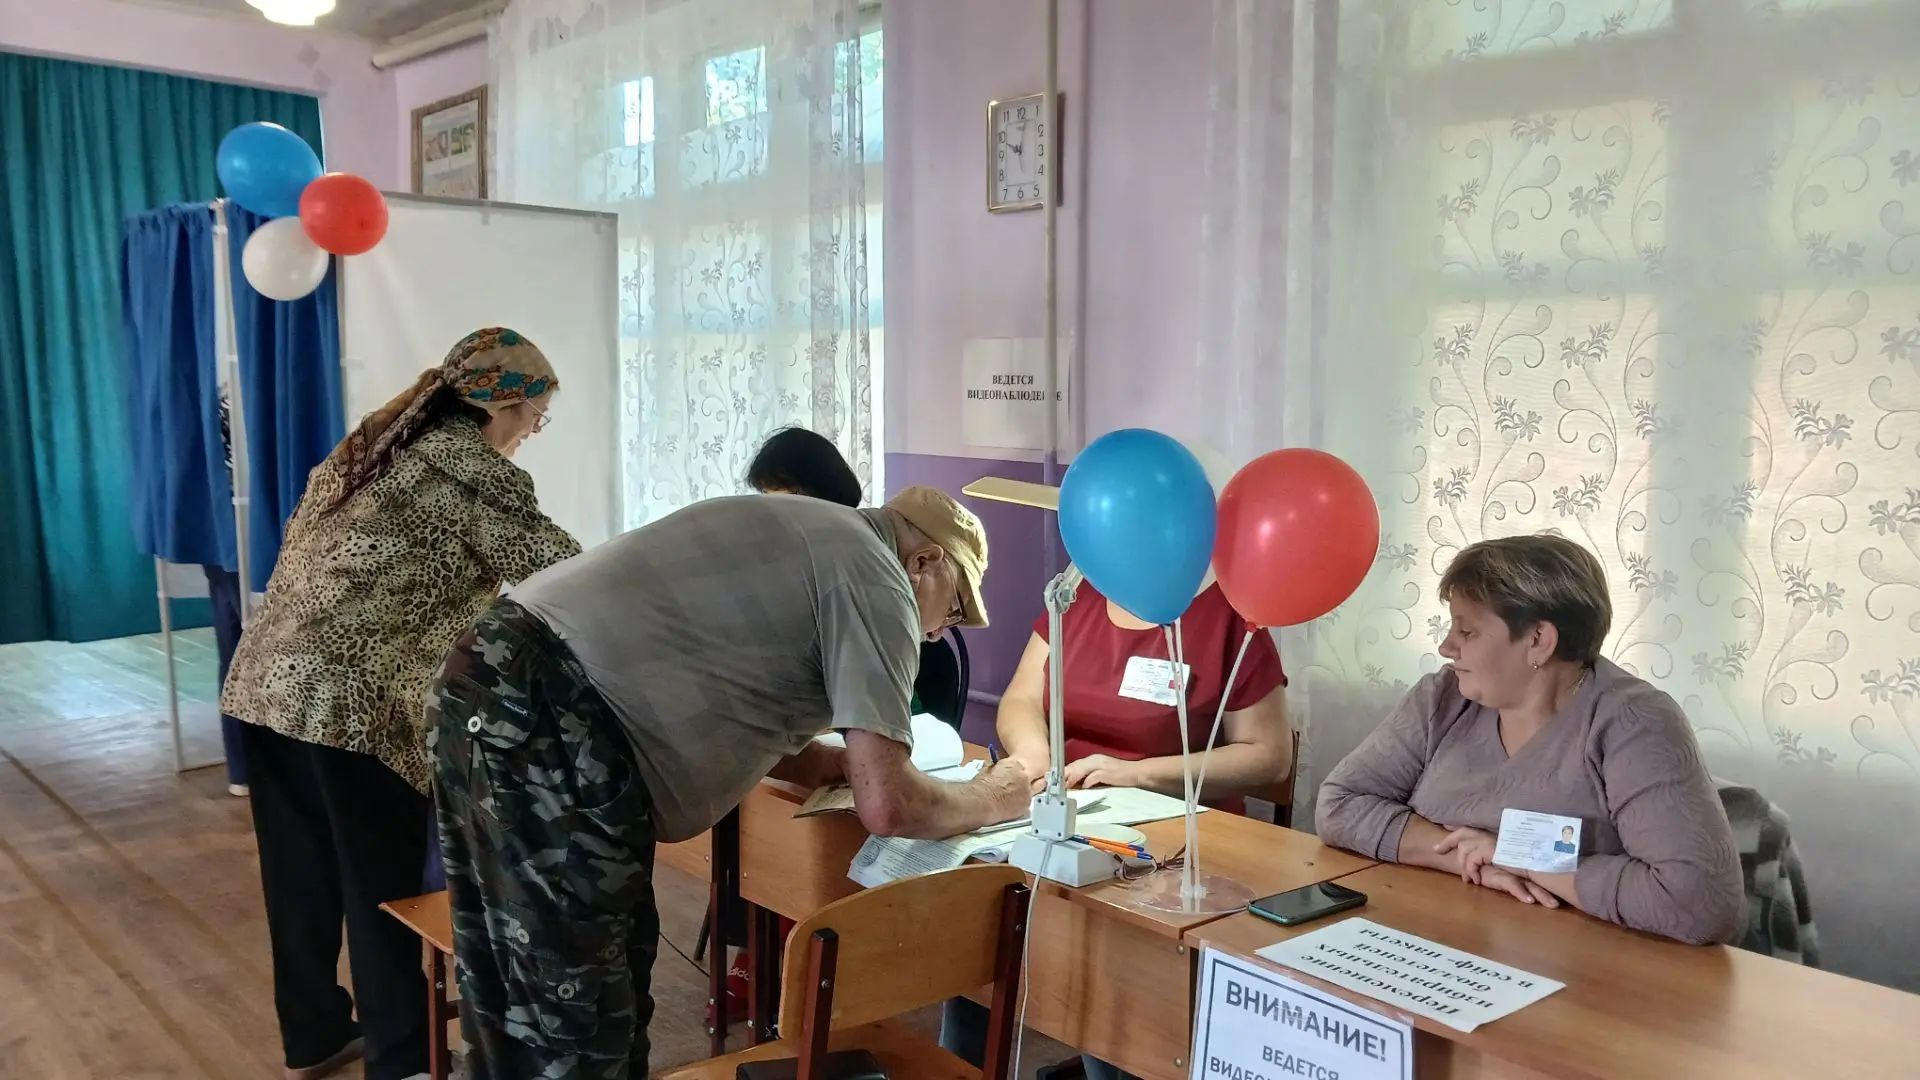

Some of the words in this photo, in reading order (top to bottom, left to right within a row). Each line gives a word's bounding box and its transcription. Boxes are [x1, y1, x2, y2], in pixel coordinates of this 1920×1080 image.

[1003, 110, 1010, 122] 11
[1017, 107, 1026, 120] 12
[1035, 105, 1039, 117] 1
[998, 130, 1006, 144] 10
[1037, 124, 1044, 137] 2
[998, 150, 1004, 161] 9
[1038, 143, 1044, 157] 3
[999, 168, 1004, 182] 8
[1037, 164, 1044, 176] 4
[1003, 188, 1008, 200] 7
[1017, 187, 1024, 199] 6
[1033, 184, 1040, 197] 5
[992, 374, 1034, 385] ВЕДЕТСЯ
[967, 389, 1063, 402] ВИДЕОНАБЛЮДЕЕ
[1359, 929, 1443, 958] пакеты
[1352, 943, 1491, 992] бюллетеней
[1315, 943, 1494, 1009] избирательных
[1300, 955, 1460, 1015] Перемещение
[1225, 979, 1387, 1062] ВНИМАНИЕ!
[1262, 1045, 1340, 1080] ВЕДЕТСЯ
